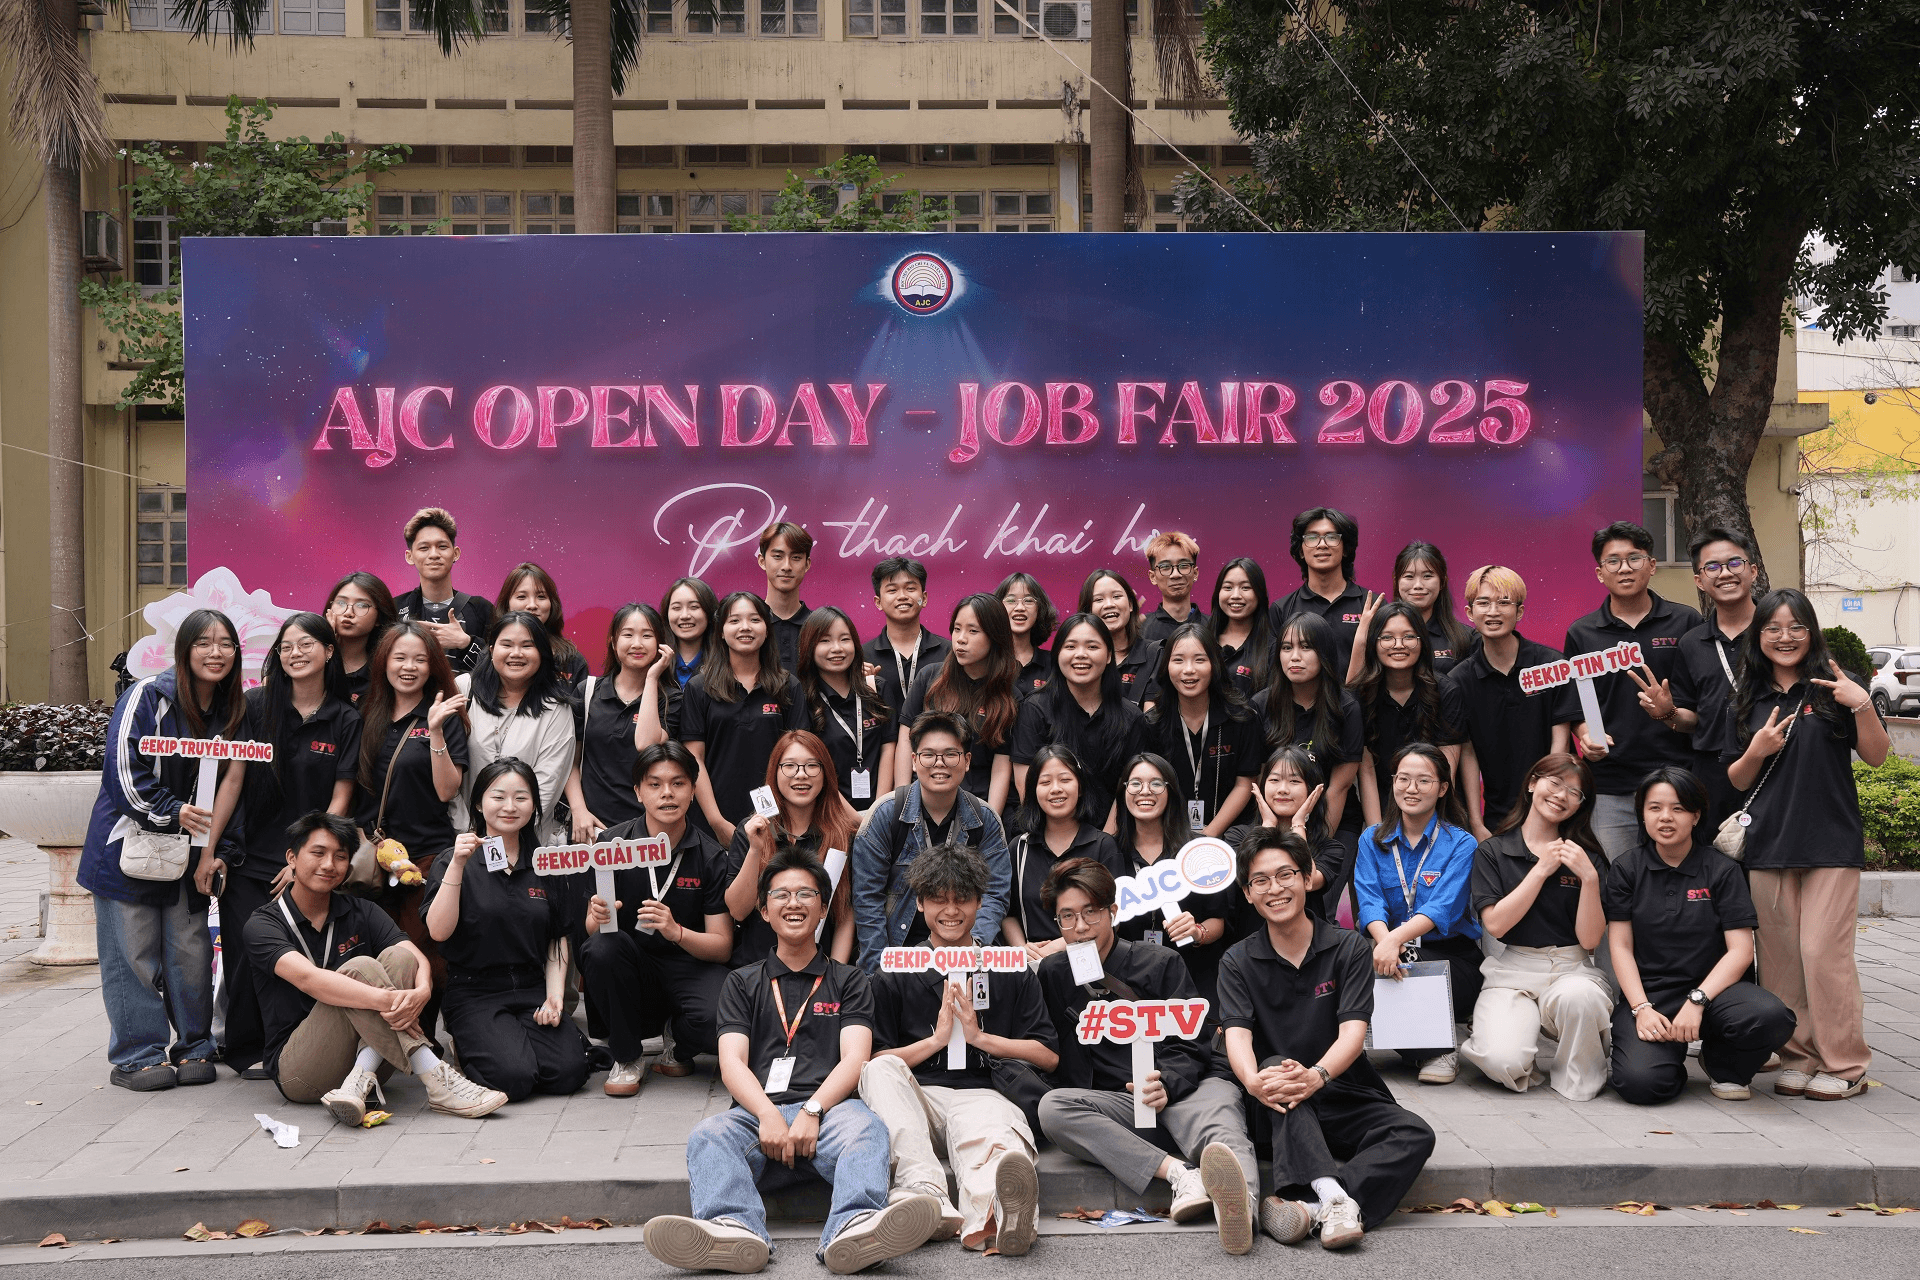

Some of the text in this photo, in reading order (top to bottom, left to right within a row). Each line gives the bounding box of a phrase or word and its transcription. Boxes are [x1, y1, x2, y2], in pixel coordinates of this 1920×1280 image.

[313, 386, 455, 468] AJC
[473, 384, 700, 450] OPEN
[719, 382, 887, 448] DAY
[948, 381, 1100, 464] JOB
[1117, 381, 1297, 445] FAIR
[1317, 379, 1531, 445] 2025
[983, 501, 1094, 560] khai
[1651, 637, 1678, 647] STV
[1237, 665, 1252, 676] ST
[1522, 645, 1642, 689] #EKIP TIN TỨC
[1121, 673, 1137, 683] ST
[763, 703, 781, 713] ST
[863, 718, 878, 729] ST
[141, 738, 272, 760] #EKIP TRUYỀN THÔNG
[310, 740, 337, 754] STV
[537, 838, 667, 871] #EKIP GIẢI TRÍ
[675, 876, 702, 888] STV
[1206, 876, 1221, 886] AJC
[1560, 875, 1577, 886] ST
[1120, 869, 1181, 911] AJC
[338, 934, 359, 954] STV
[883, 950, 1025, 971] #EKIP QUAY PHIM
[1314, 979, 1337, 997] STV
[814, 1001, 841, 1014] STV
[1081, 1003, 1205, 1040] #STV
